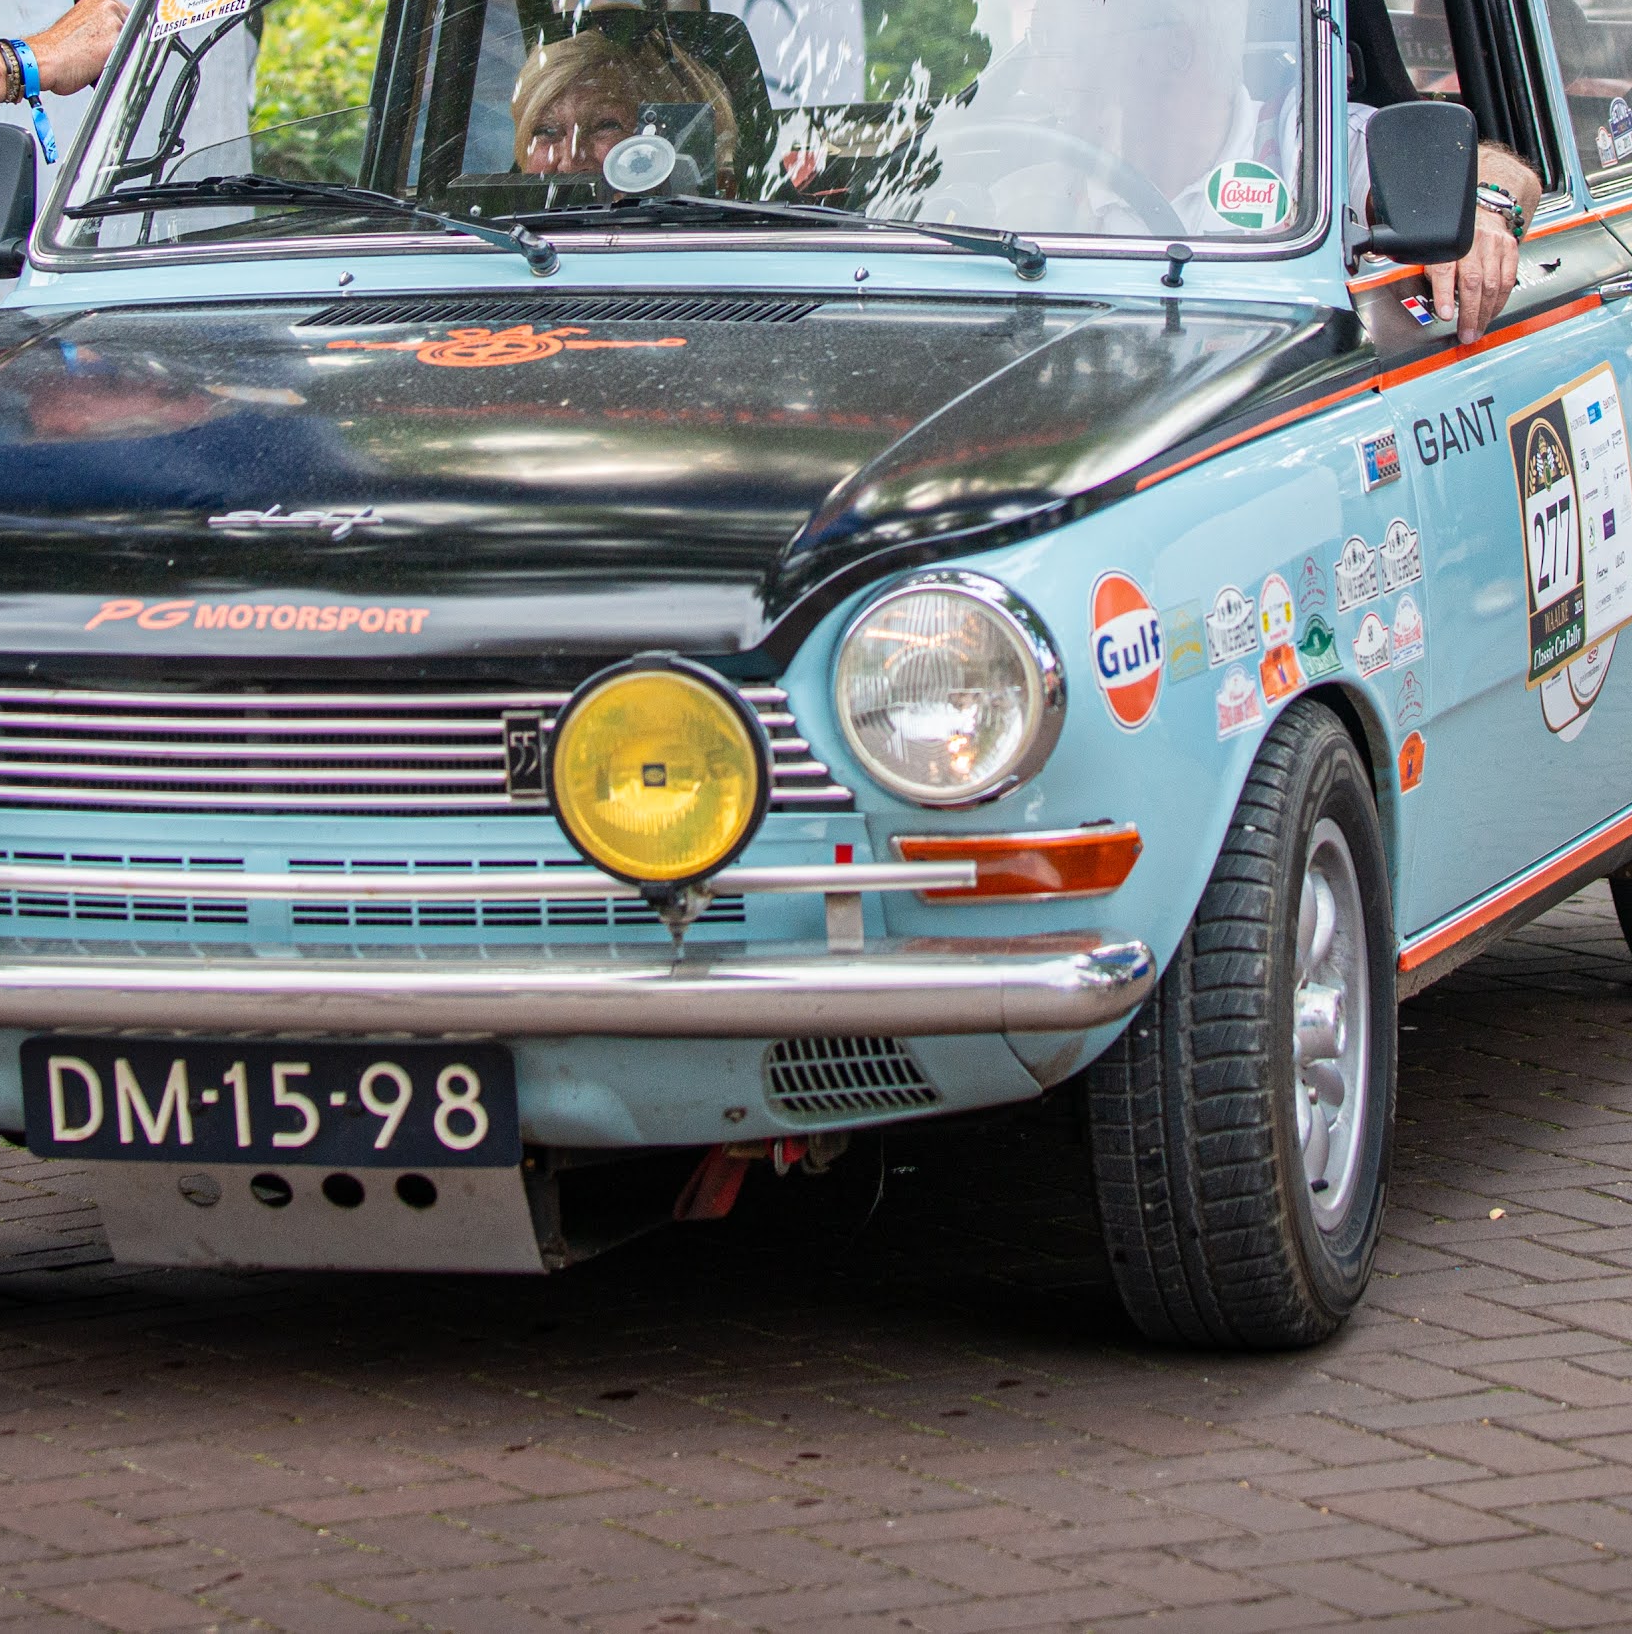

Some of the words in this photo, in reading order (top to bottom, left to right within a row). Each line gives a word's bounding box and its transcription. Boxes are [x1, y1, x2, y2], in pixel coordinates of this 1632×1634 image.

[154, 18, 187, 38] CLASSIC
[190, 9, 216, 24] RALLY
[1220, 180, 1276, 210] Castrol
[1413, 395, 1498, 466] GANT
[1533, 495, 1571, 593] 277
[85, 599, 196, 631] PG
[194, 605, 430, 634] MOTORSPORT
[1544, 599, 1569, 634] WAALRE
[1097, 618, 1161, 678] Gulf
[1534, 641, 1555, 671] Classic
[1555, 635, 1566, 657] Car
[1565, 623, 1582, 650] Rally
[509, 731, 539, 777] 55
